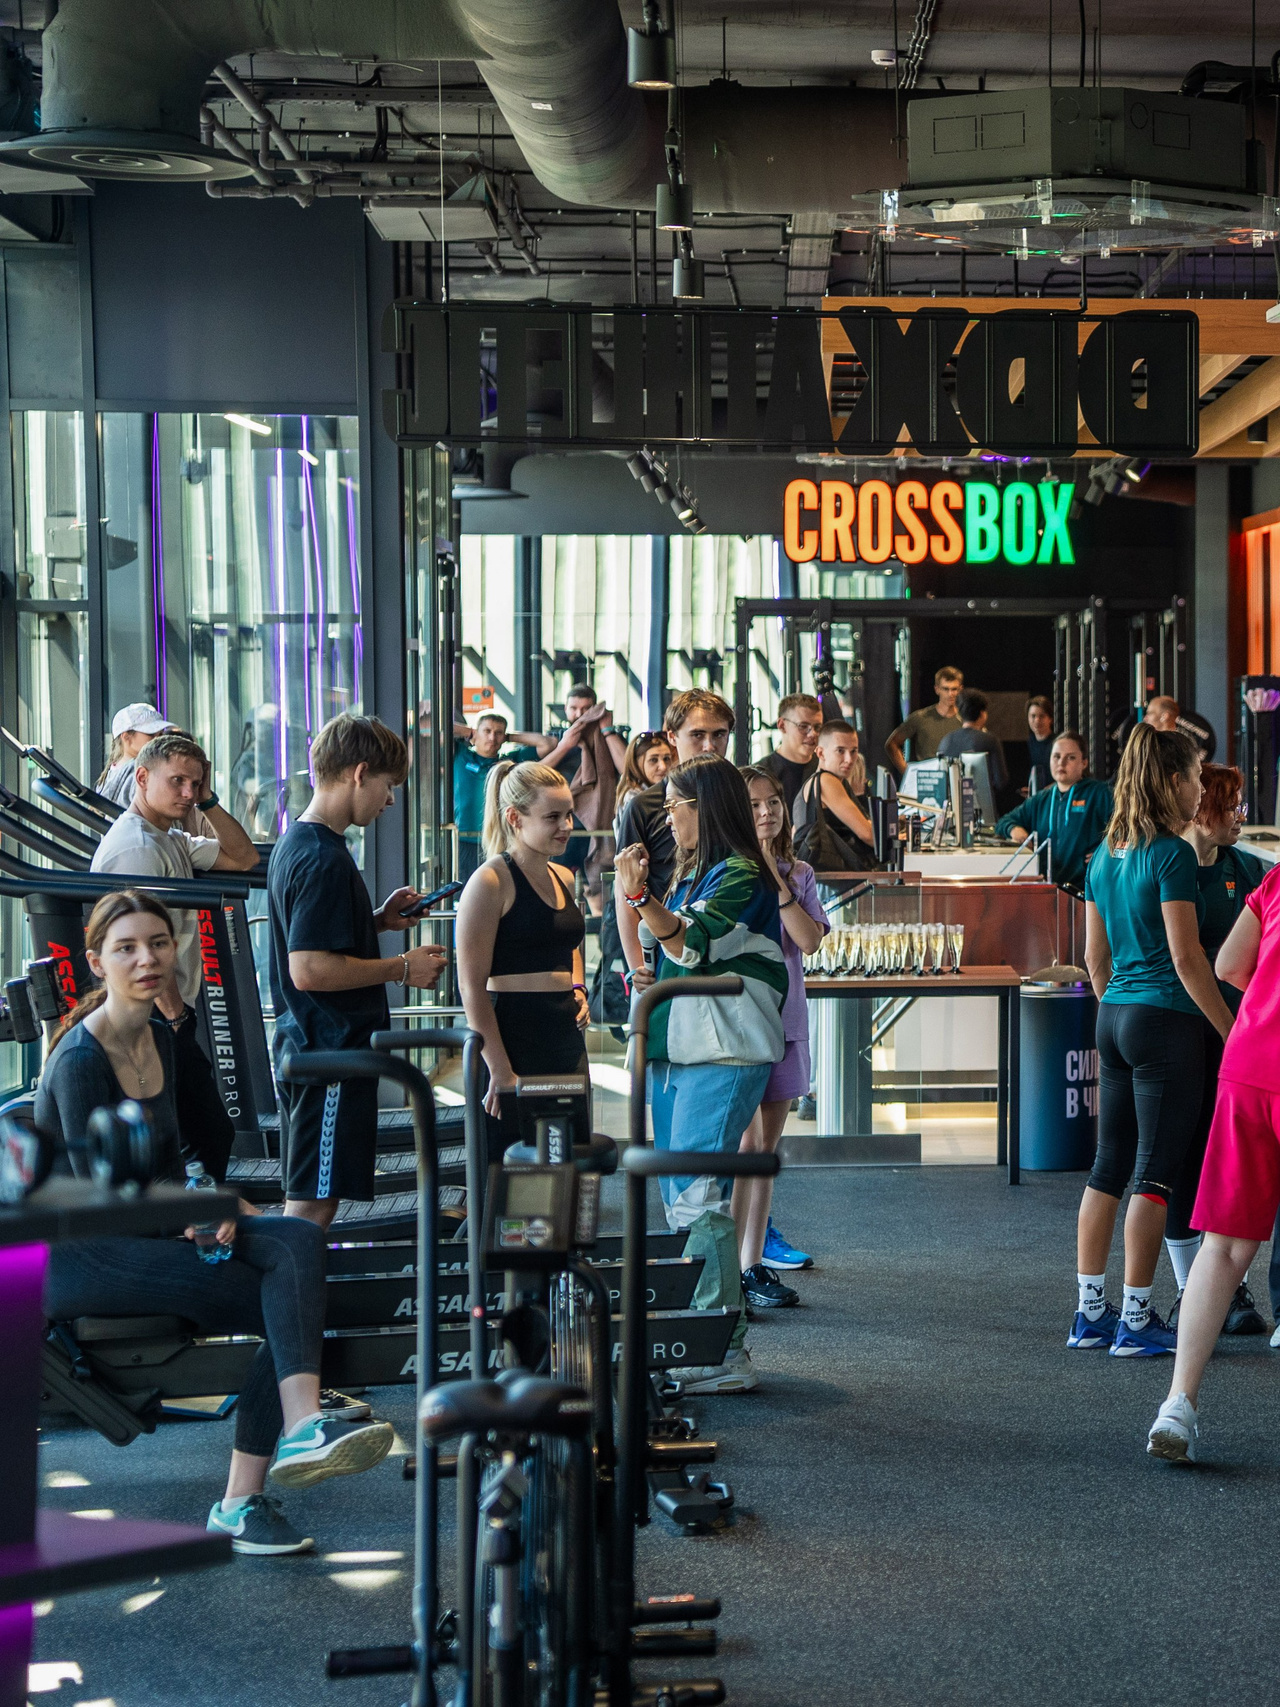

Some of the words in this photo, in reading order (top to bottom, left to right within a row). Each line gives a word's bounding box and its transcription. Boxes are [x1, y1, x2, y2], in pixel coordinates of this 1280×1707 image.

[783, 478, 1077, 565] CROSSBOX
[1066, 1048, 1100, 1082] СИЛ
[222, 1075, 242, 1118] PRO
[609, 1288, 657, 1304] PO
[653, 1342, 687, 1359] RO
